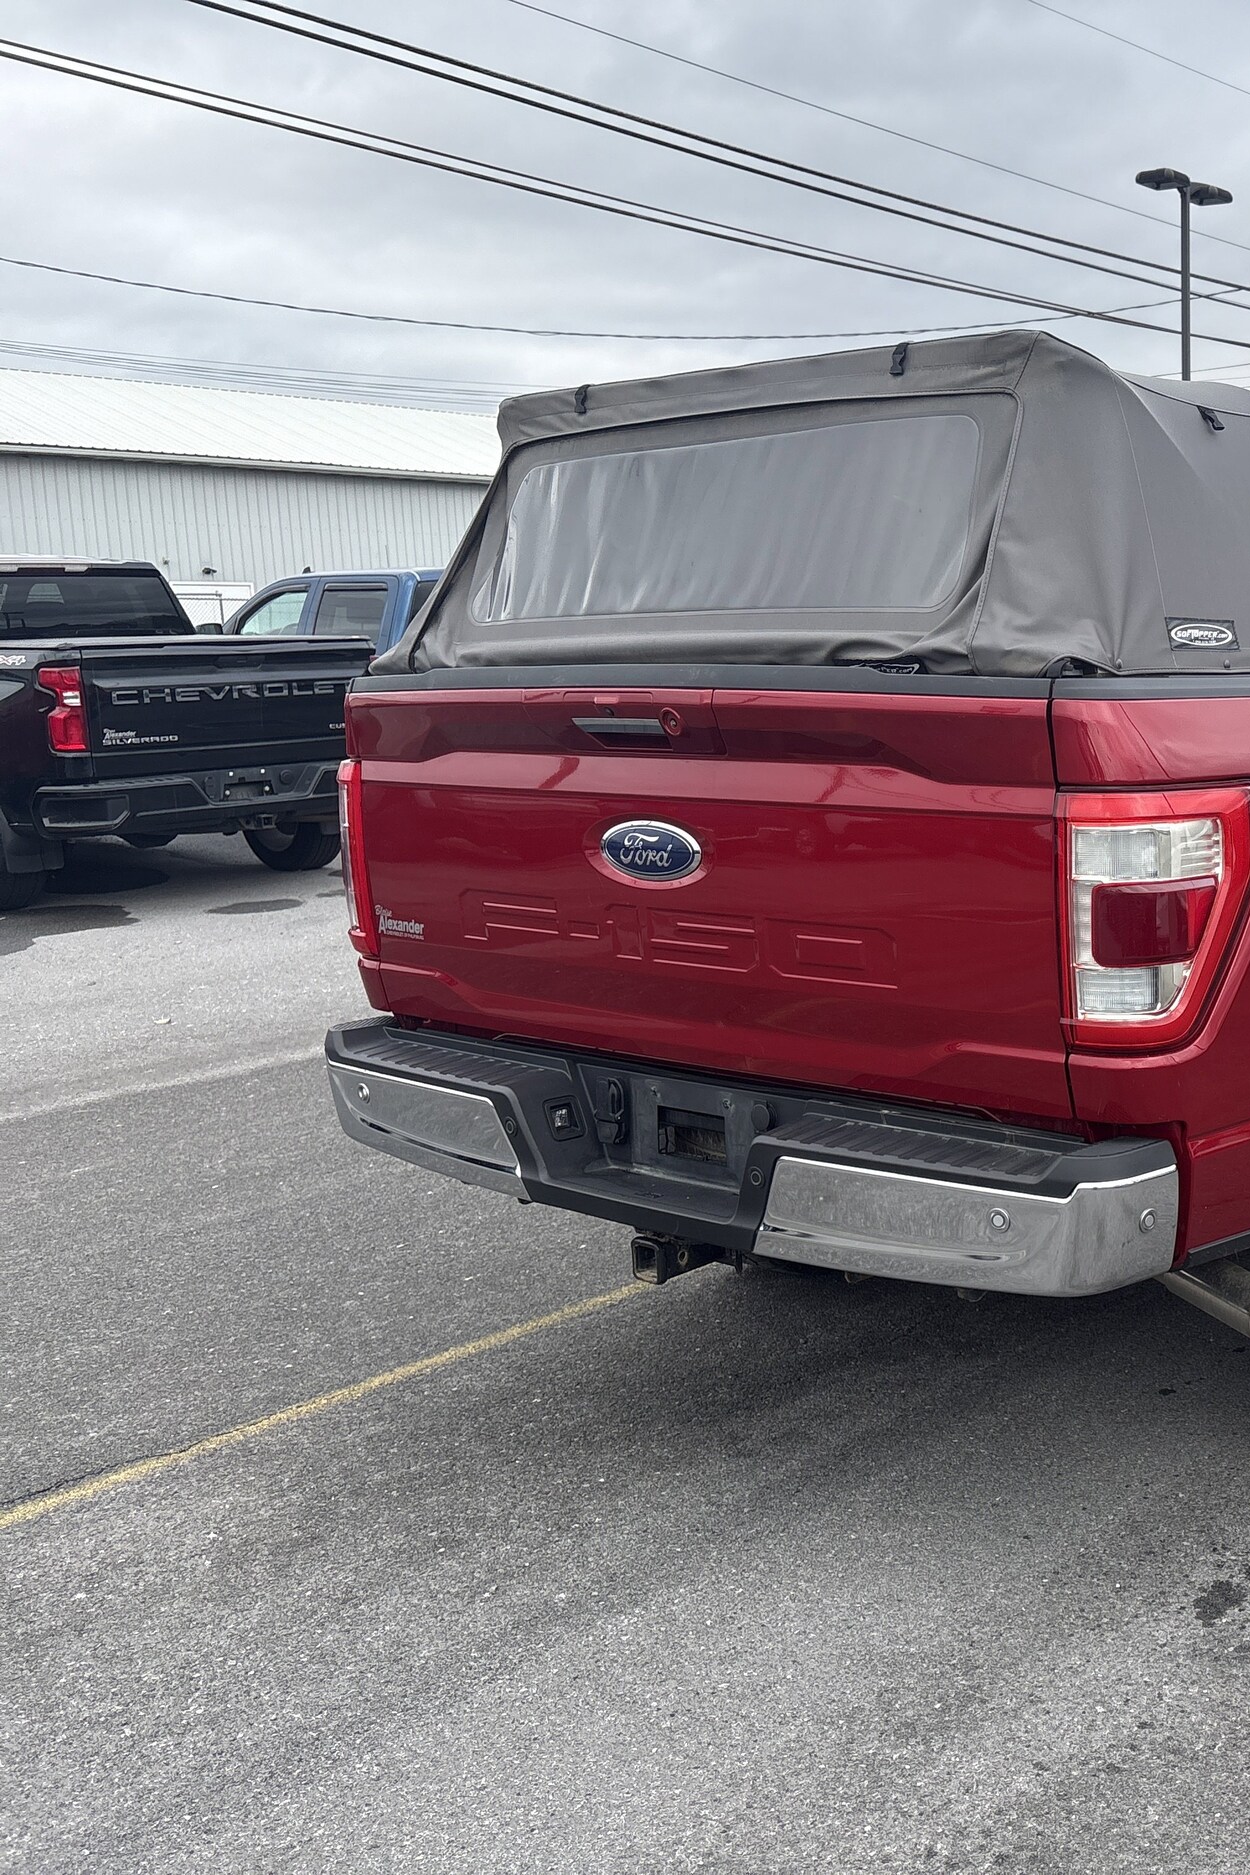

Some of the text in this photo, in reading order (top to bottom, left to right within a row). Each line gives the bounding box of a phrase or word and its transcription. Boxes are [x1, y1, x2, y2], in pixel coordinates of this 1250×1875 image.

[103, 735, 179, 746] SILVERADO
[620, 833, 673, 867] Ford
[378, 915, 425, 935] Alexander
[459, 888, 898, 989] F-150
